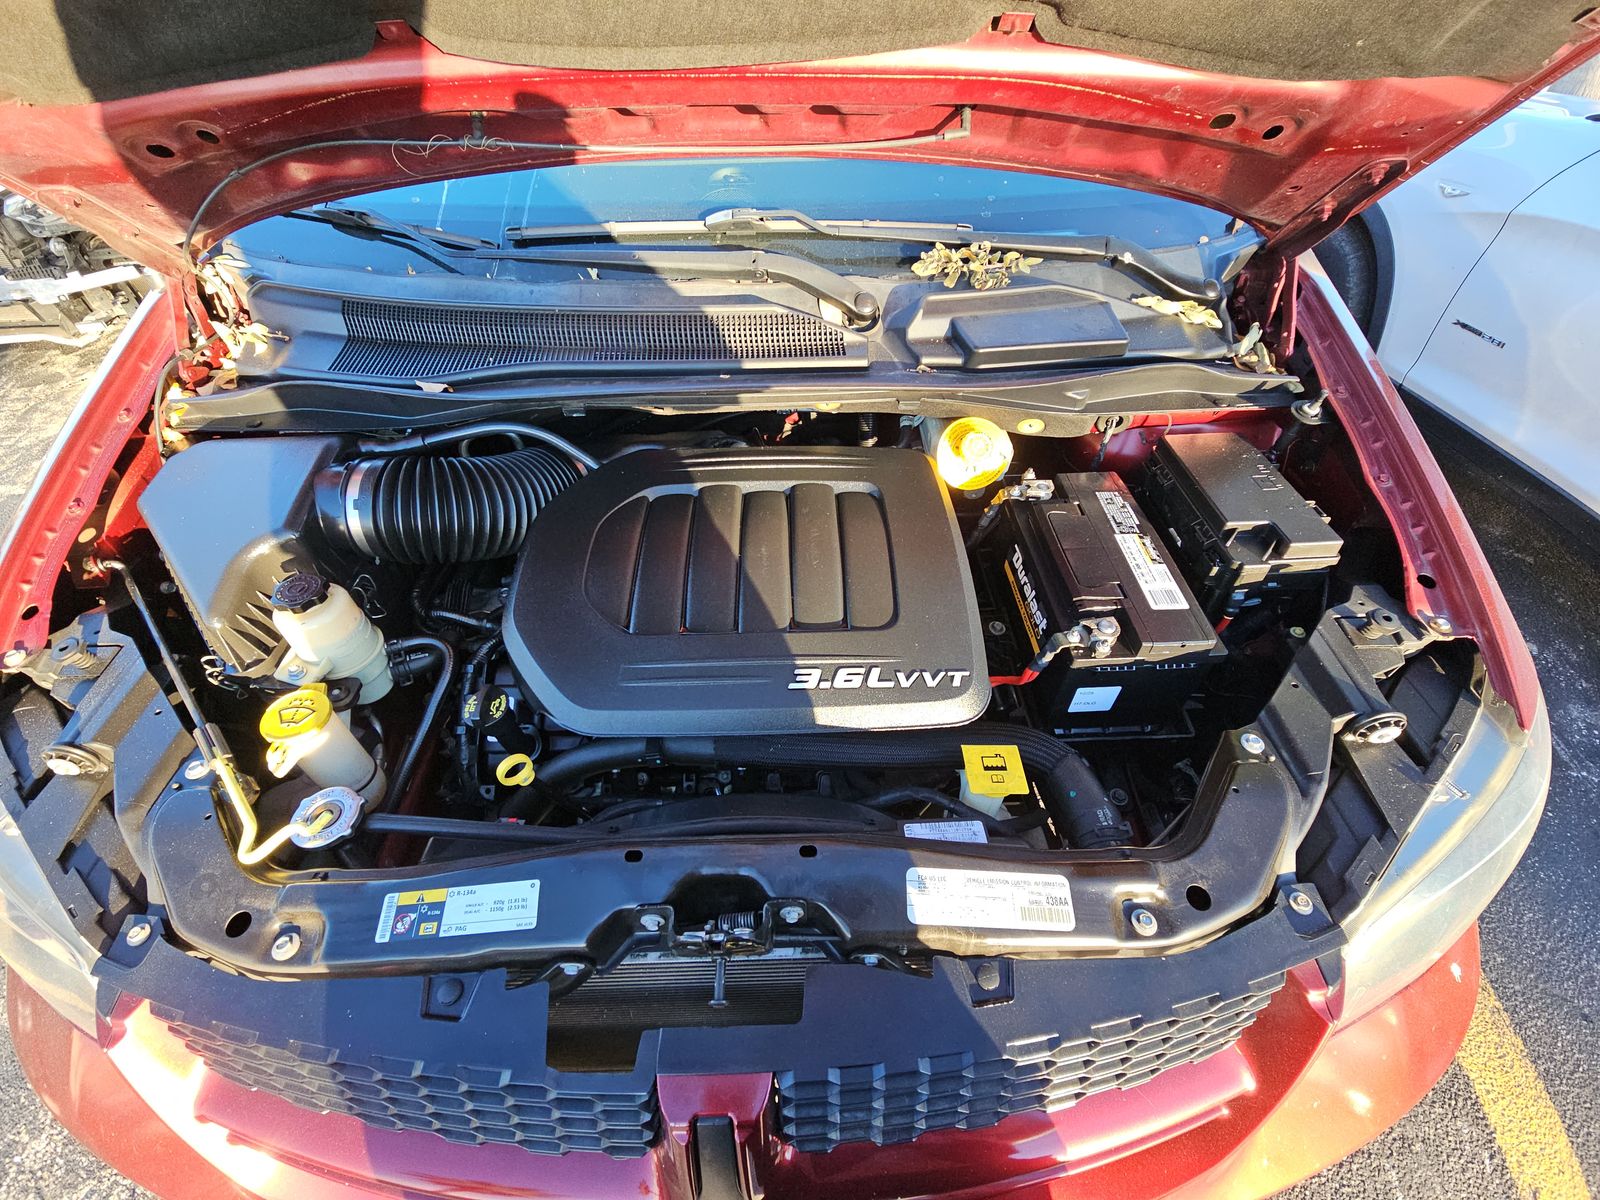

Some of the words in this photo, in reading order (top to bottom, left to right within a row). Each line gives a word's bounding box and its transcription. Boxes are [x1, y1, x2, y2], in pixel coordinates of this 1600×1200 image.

[1012, 543, 1048, 635] Duralast
[787, 667, 895, 690] 3.6L
[896, 671, 971, 688] VVT
